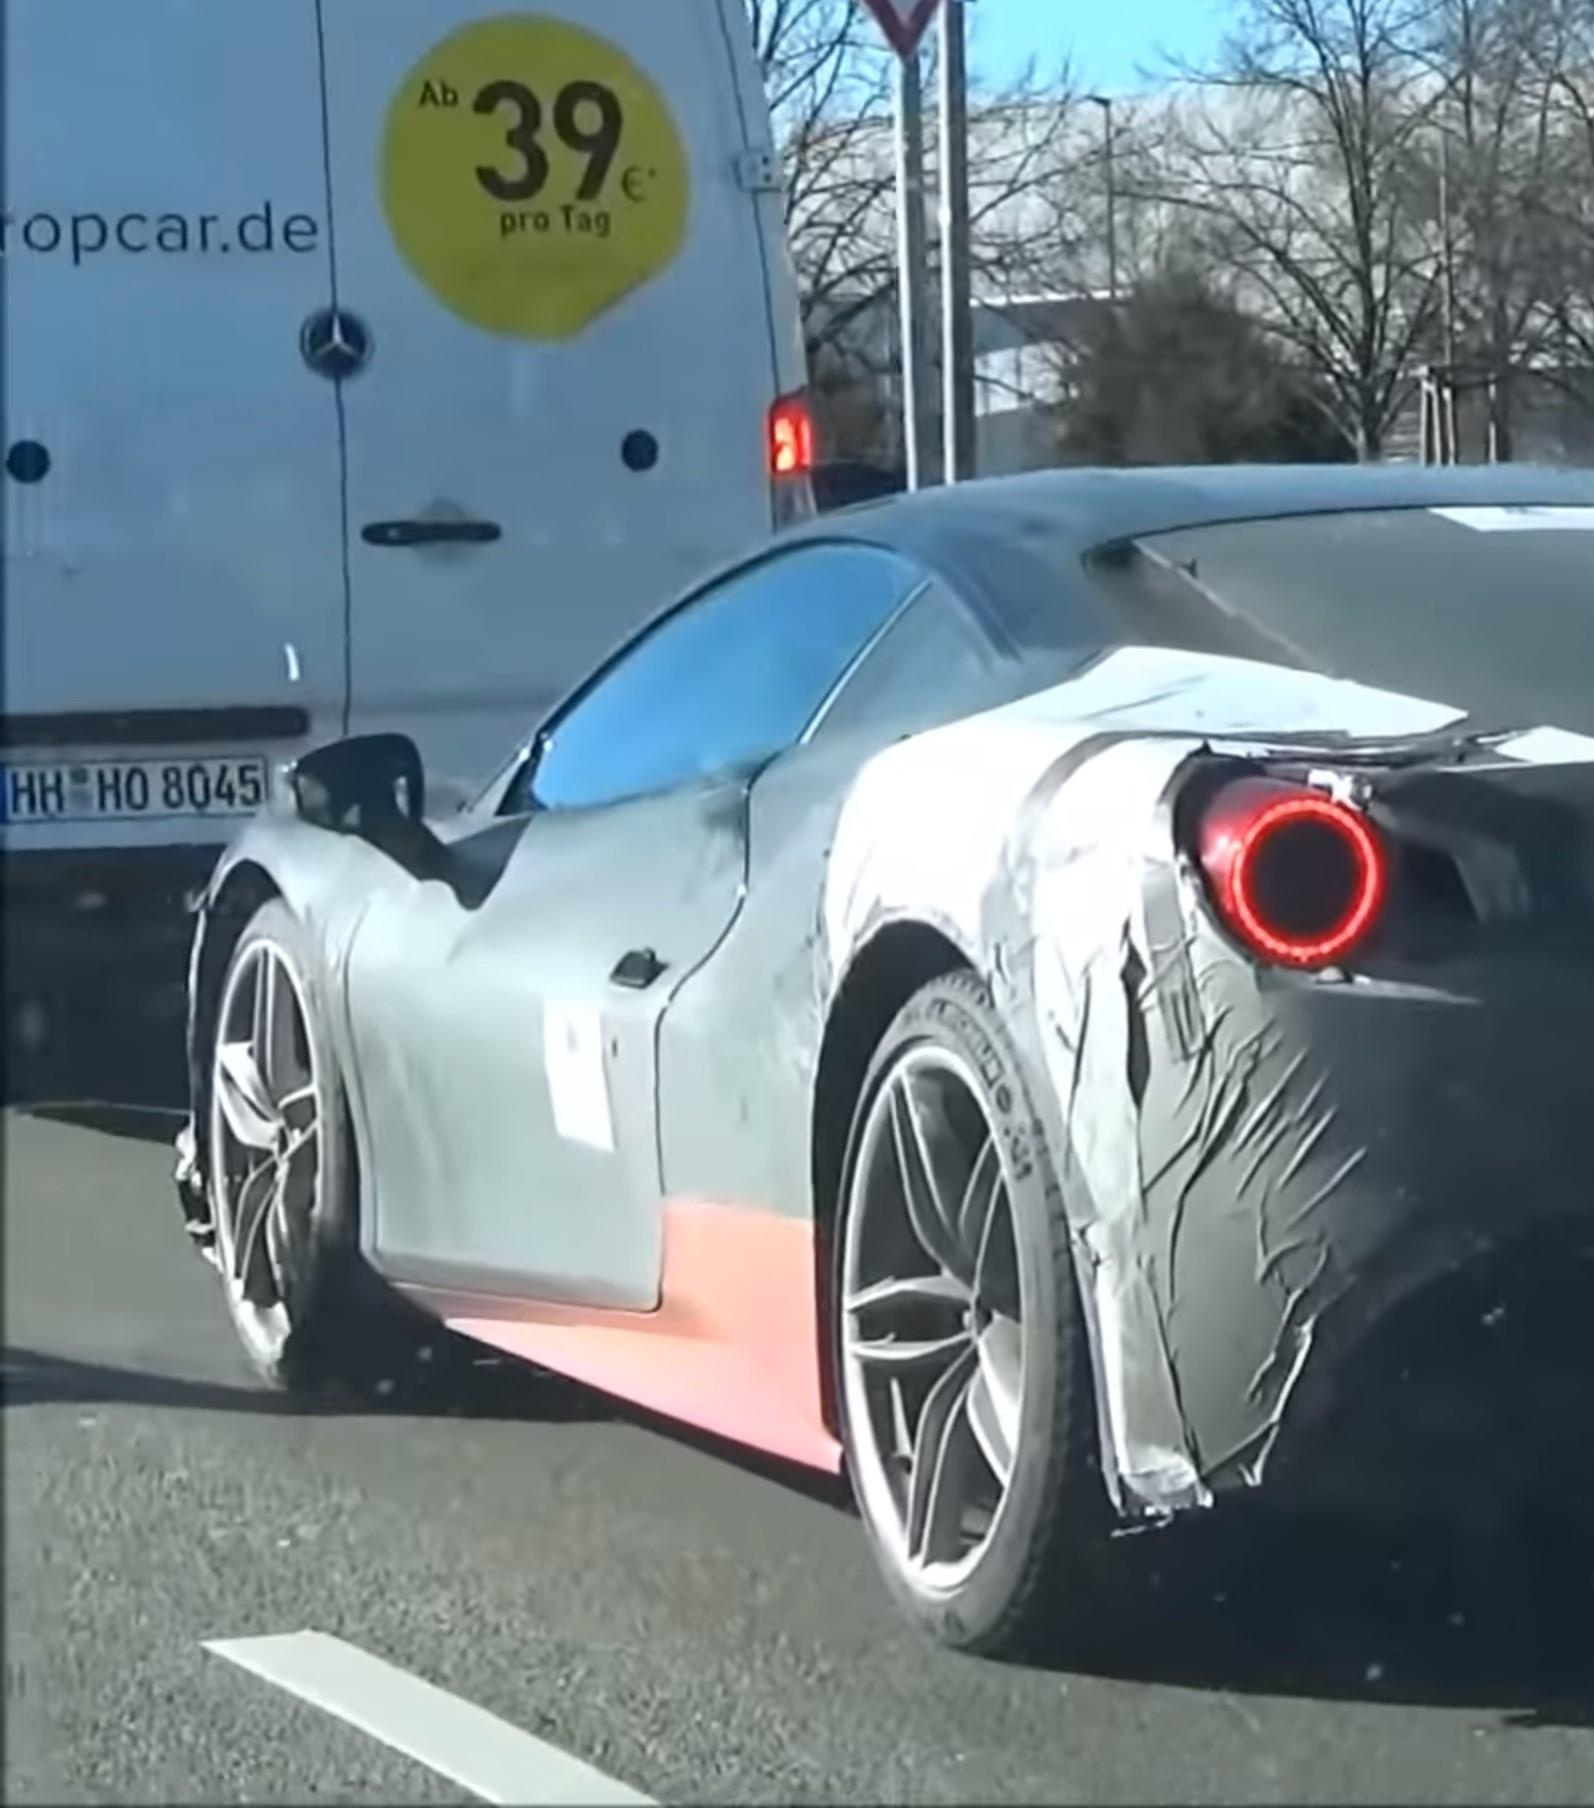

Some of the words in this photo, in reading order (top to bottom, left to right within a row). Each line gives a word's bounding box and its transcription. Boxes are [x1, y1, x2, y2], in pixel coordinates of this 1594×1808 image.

[419, 80, 459, 108] Ab
[500, 210, 549, 237] pro
[560, 205, 611, 238] Tag
[11, 768, 64, 813] HH
[97, 768, 149, 811] HO
[162, 764, 260, 808] 8045
